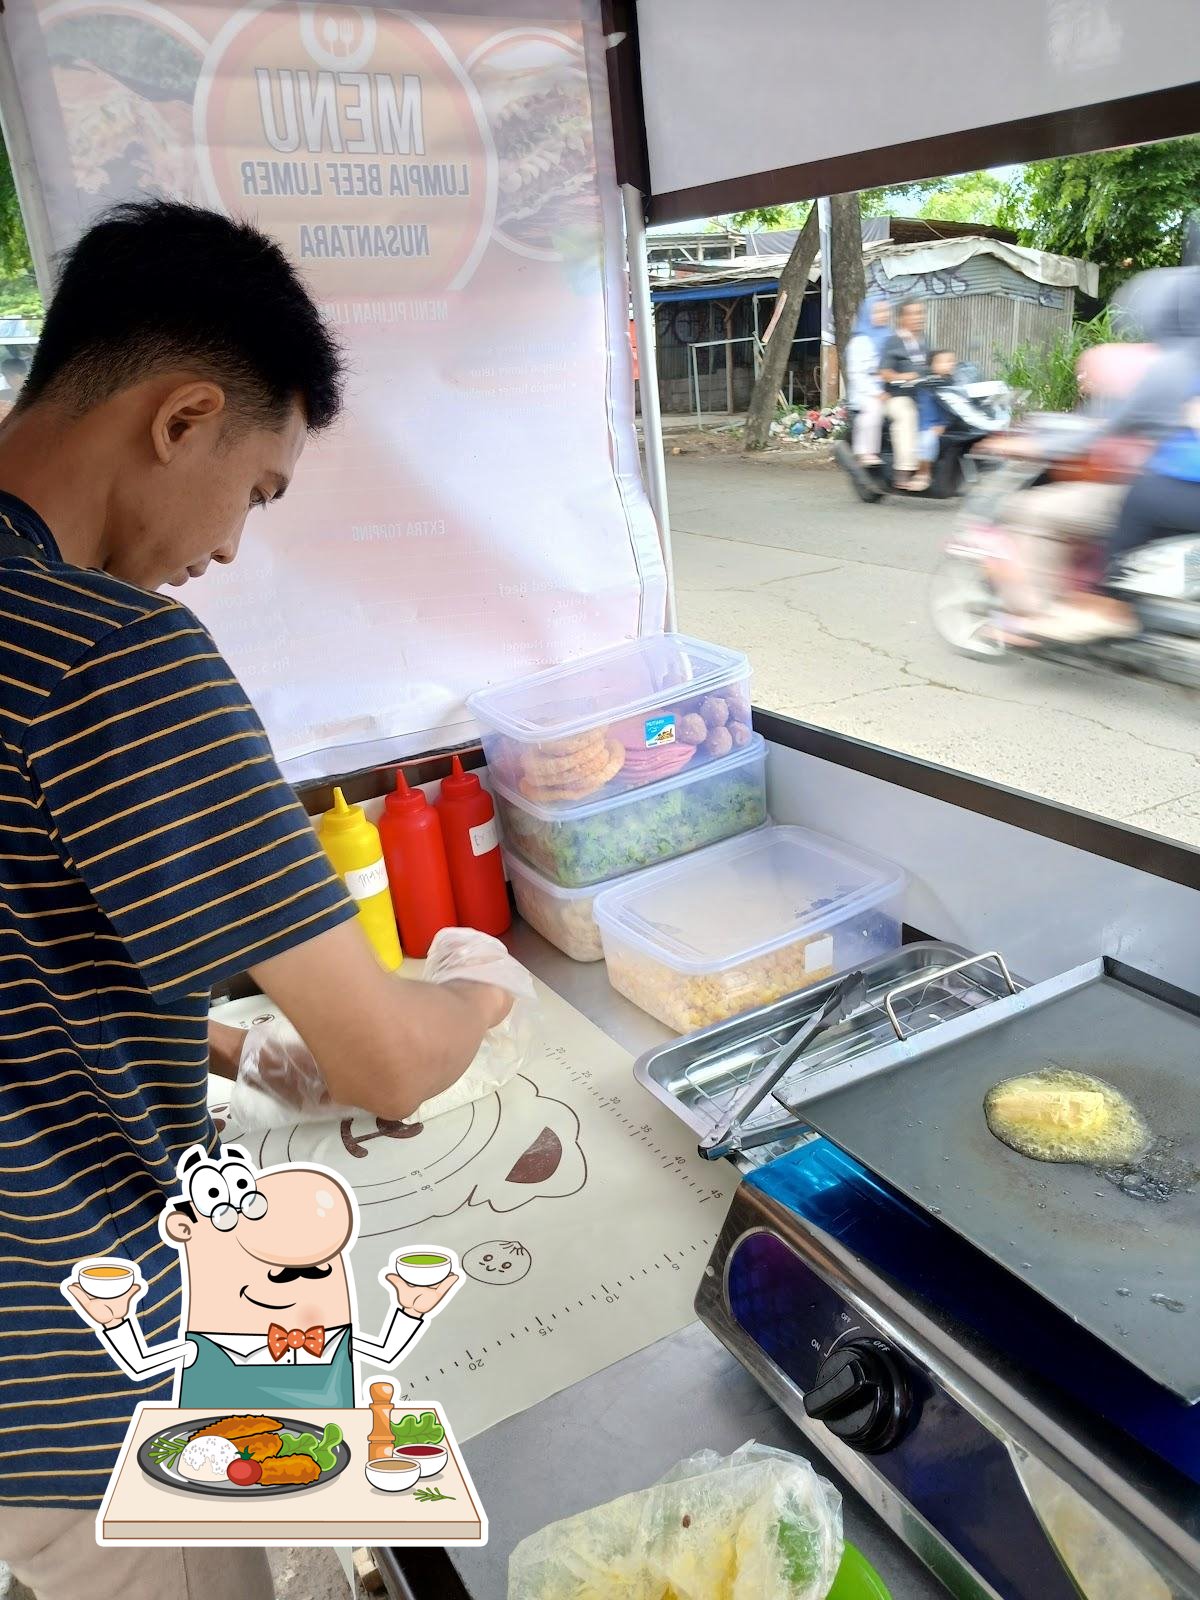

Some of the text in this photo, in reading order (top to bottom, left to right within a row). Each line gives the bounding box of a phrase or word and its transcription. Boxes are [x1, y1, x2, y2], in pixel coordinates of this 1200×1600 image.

[640, 1124, 653, 1133] 35
[674, 1156, 686, 1165] 40
[711, 1190, 724, 1199] 45
[672, 1263, 681, 1271] 5
[606, 1293, 620, 1304] 10
[538, 1325, 554, 1337] 15
[810, 1339, 821, 1351] ON
[872, 1340, 891, 1352] OFF
[468, 1358, 485, 1371] 20
